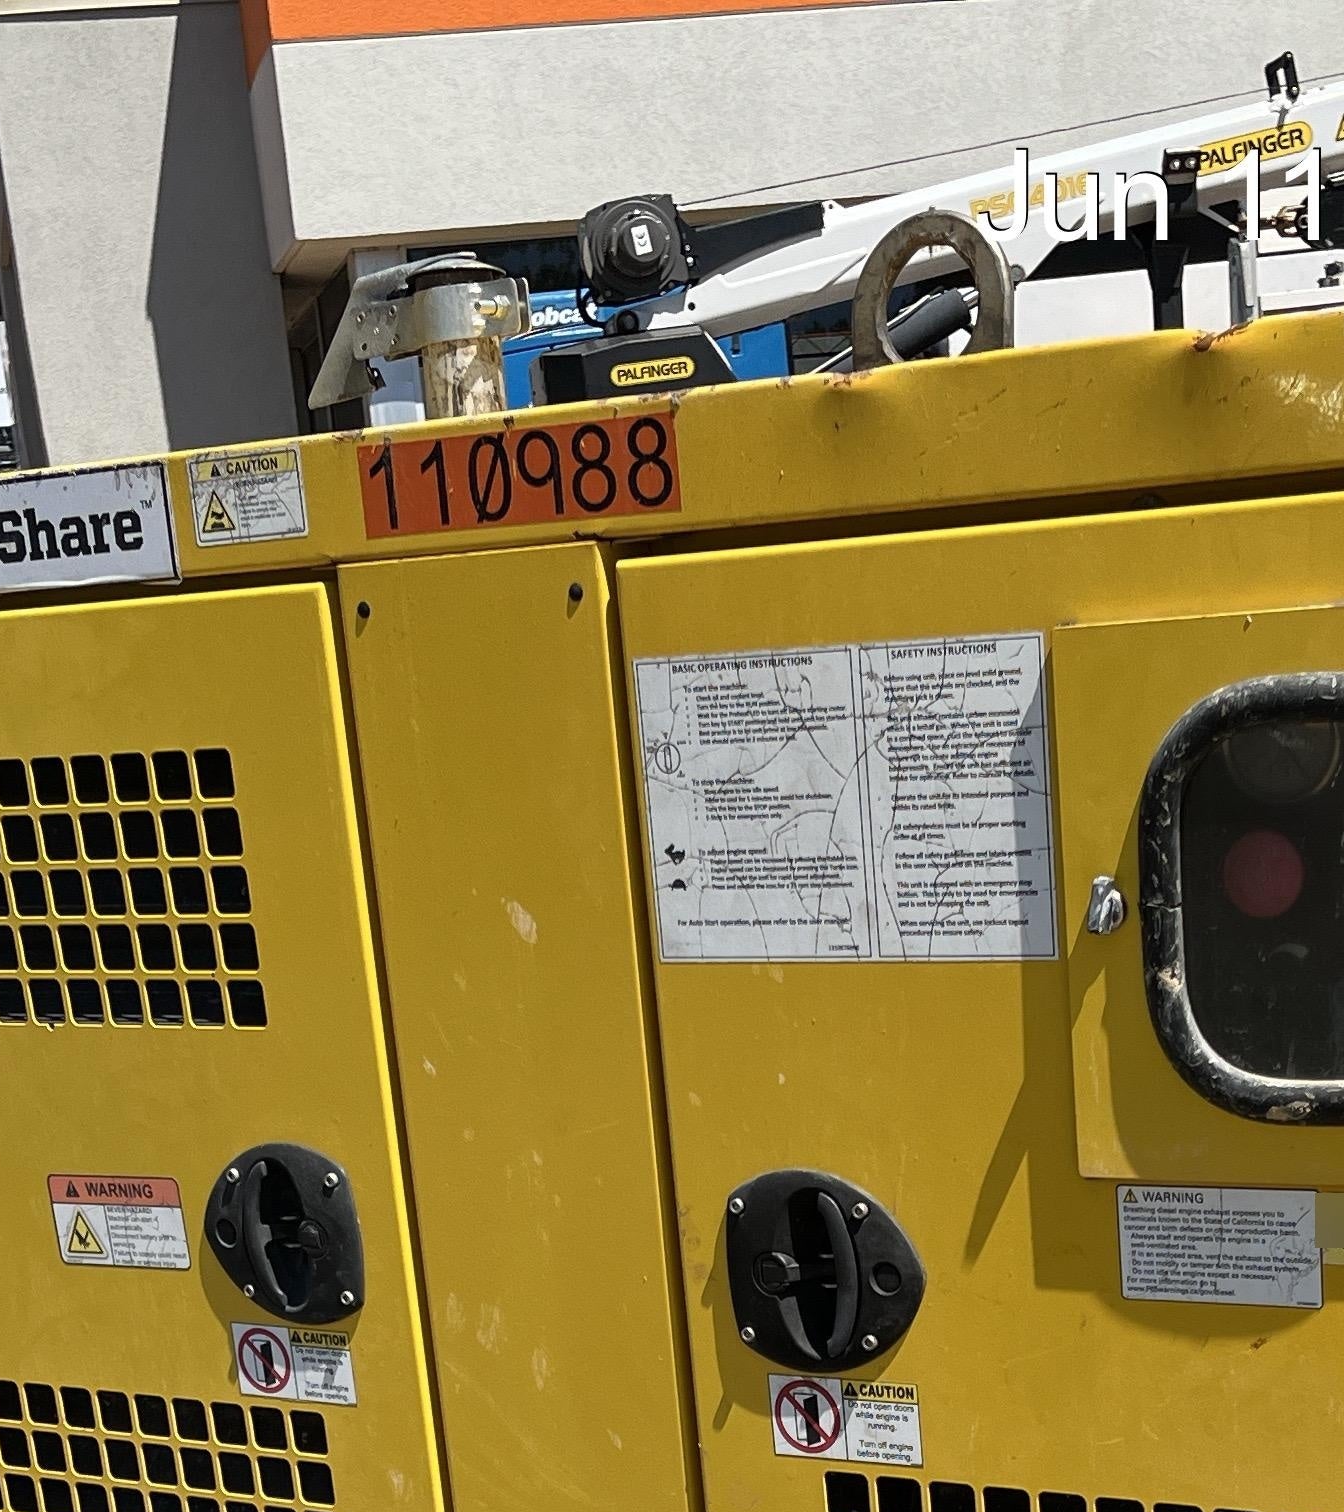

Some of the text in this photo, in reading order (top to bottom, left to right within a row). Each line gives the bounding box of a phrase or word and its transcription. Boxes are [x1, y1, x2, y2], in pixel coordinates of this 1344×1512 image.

[1200, 128, 1305, 168] PALFINGER
[530, 299, 598, 327] obcat
[617, 361, 689, 383] PALFINGER
[226, 457, 278, 475] CAUTION
[368, 417, 674, 530] 110988
[890, 643, 996, 659] SAFETY INSTRUCTIONS
[672, 656, 813, 674] BASIC OPERATING INSTRUCTIONS
[693, 684, 706, 692] start
[85, 1181, 154, 1199] WARNING
[1142, 1191, 1203, 1203] WARNING
[1232, 1218, 1264, 1226] California
[302, 1331, 347, 1347] CAUTION
[859, 1384, 915, 1400] CAUTION
[847, 1400, 858, 1408] Do
[873, 1403, 892, 1412] open
[893, 1404, 914, 1412] doors
[855, 1411, 908, 1422] while engine is
[856, 1449, 879, 1458] before
[858, 1439, 876, 1447] Turn
[888, 1442, 913, 1452] engine
